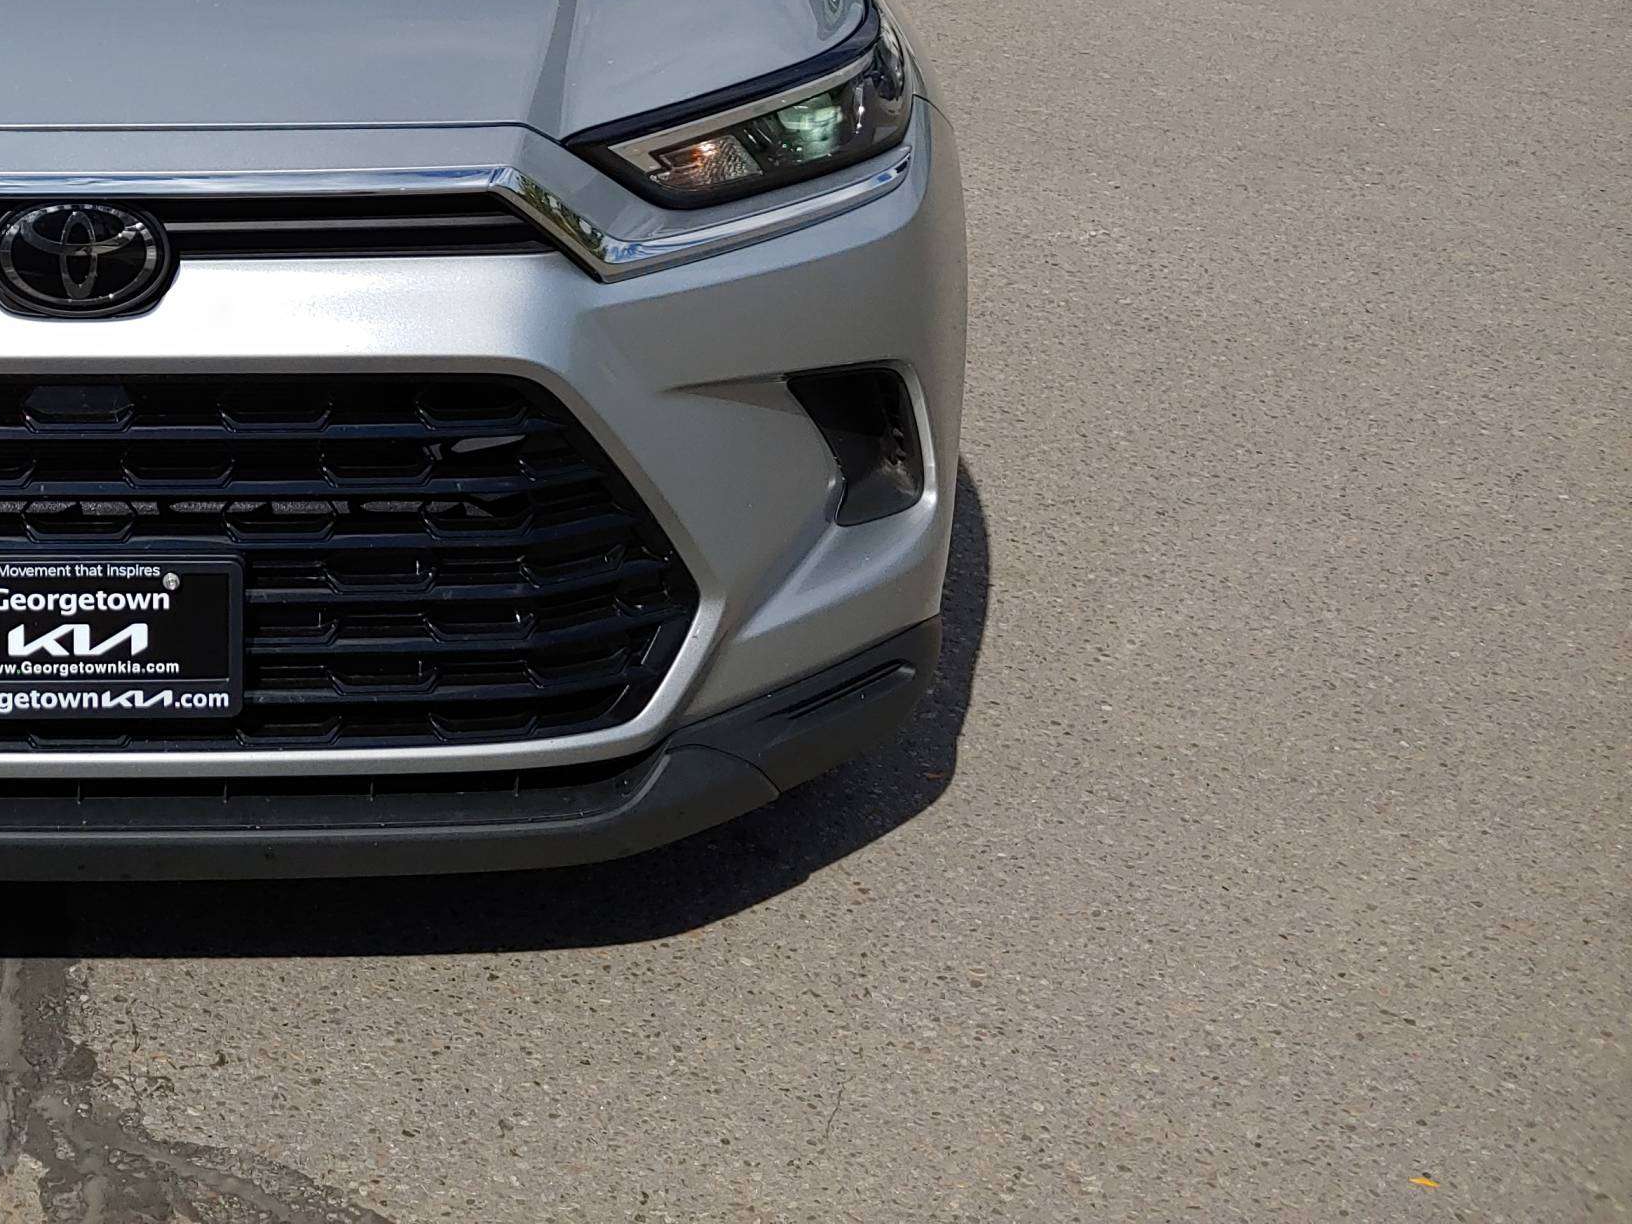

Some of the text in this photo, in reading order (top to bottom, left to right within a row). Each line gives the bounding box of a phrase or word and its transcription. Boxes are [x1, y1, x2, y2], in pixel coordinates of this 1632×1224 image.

[75, 564, 103, 577] that
[106, 564, 160, 579] inspires
[7, 623, 149, 657] KIA
